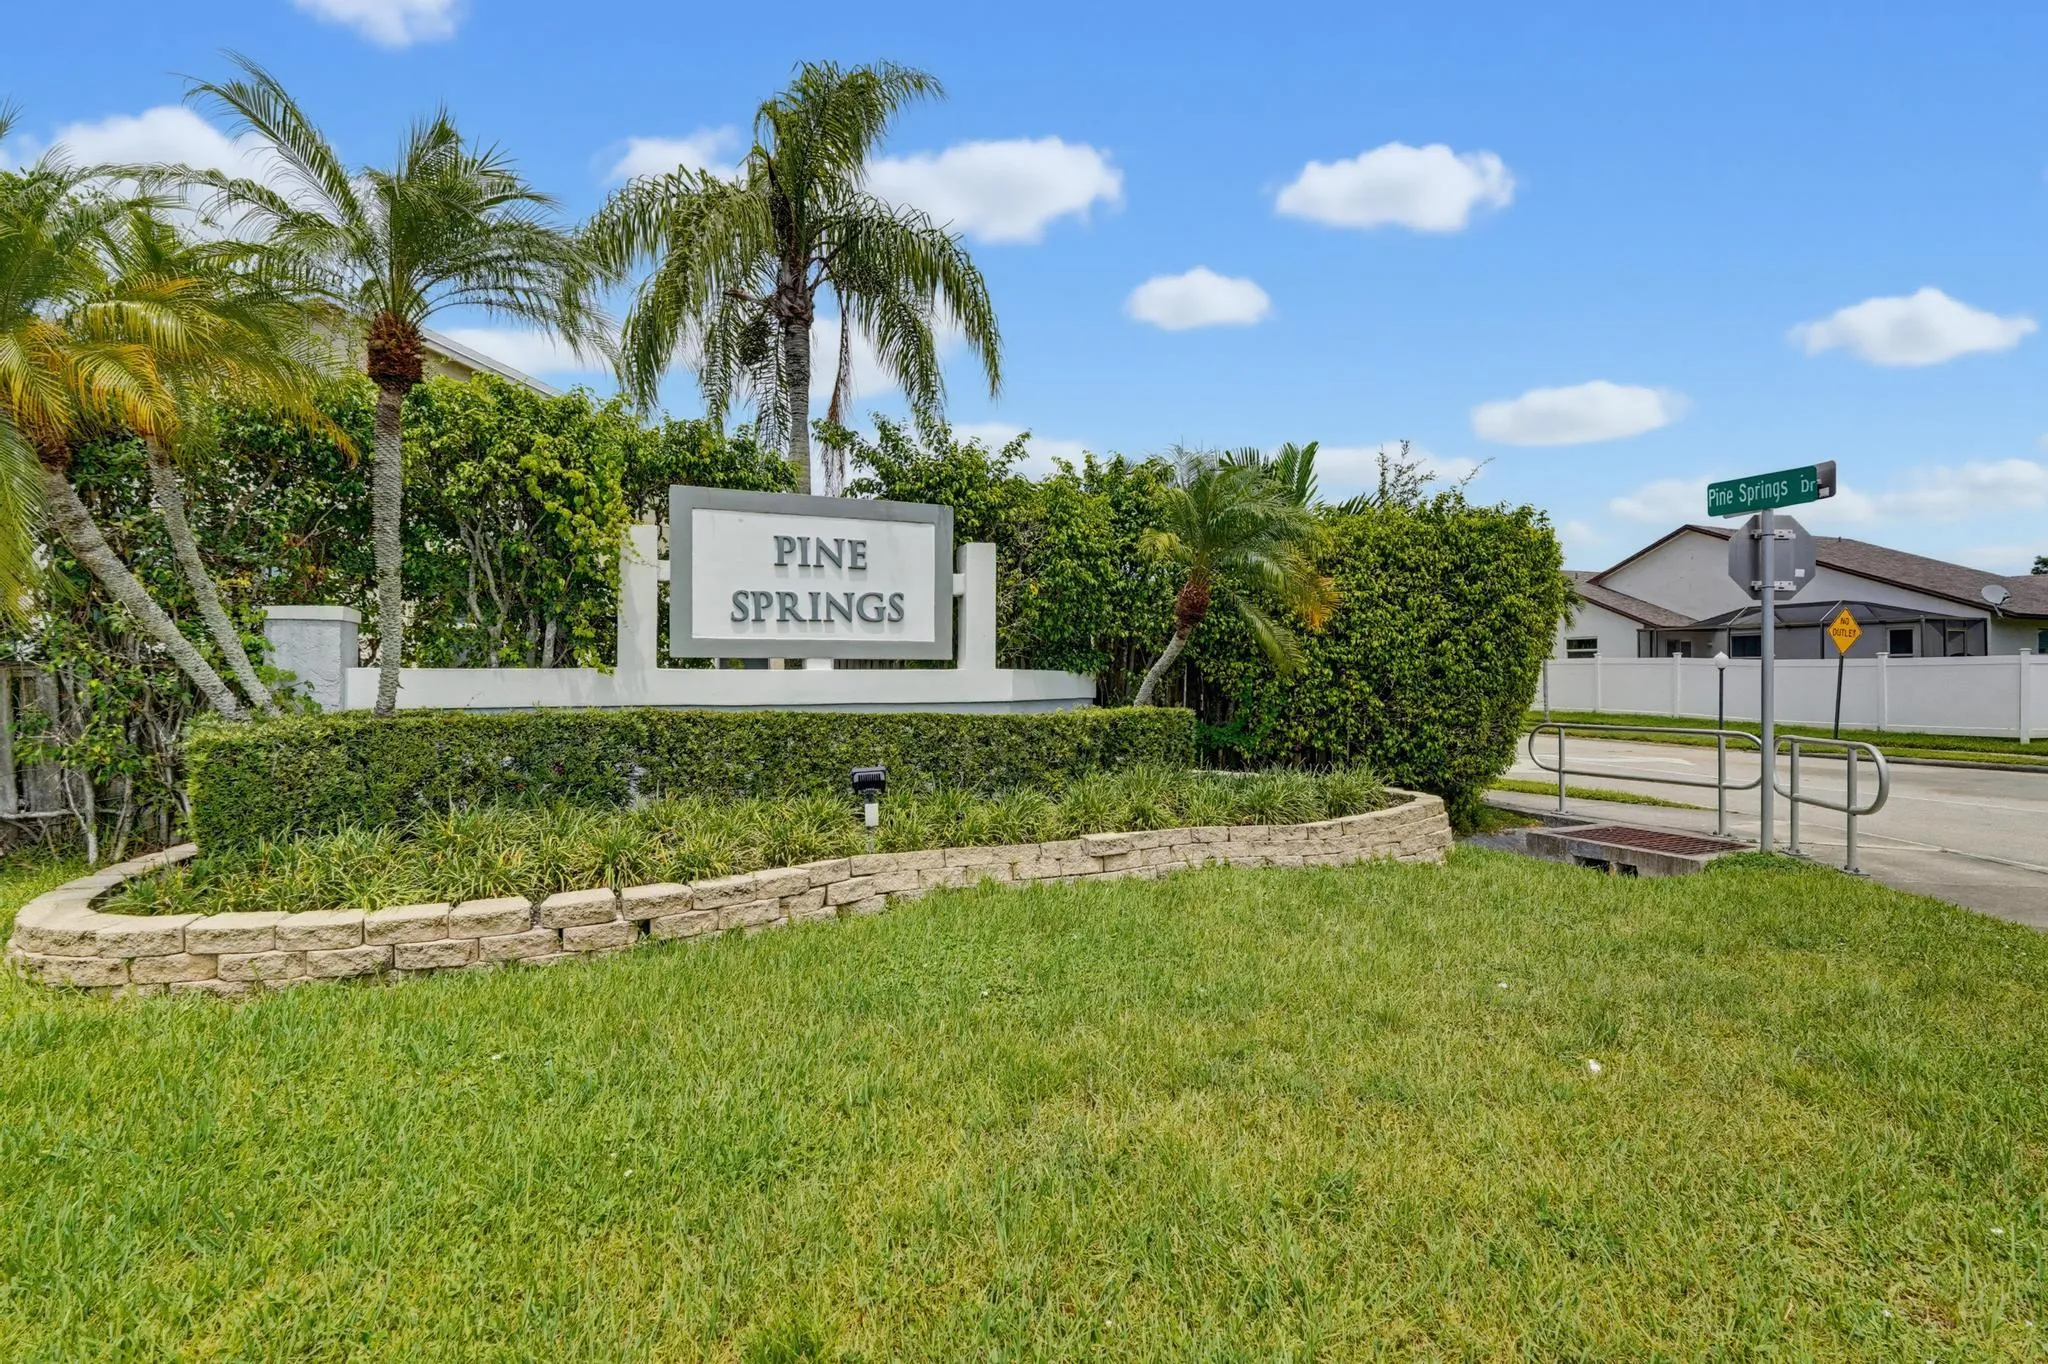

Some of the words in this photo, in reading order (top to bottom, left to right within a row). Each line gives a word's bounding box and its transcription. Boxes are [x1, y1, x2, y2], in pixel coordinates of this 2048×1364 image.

[1708, 487, 1734, 507] Pine
[1738, 479, 1789, 505] Springs
[1800, 479, 1816, 493] Dr
[773, 535, 868, 569] PINE
[730, 590, 905, 623] SPRINGS
[1832, 628, 1857, 638] OUTLET
[1840, 617, 1850, 625] NO
